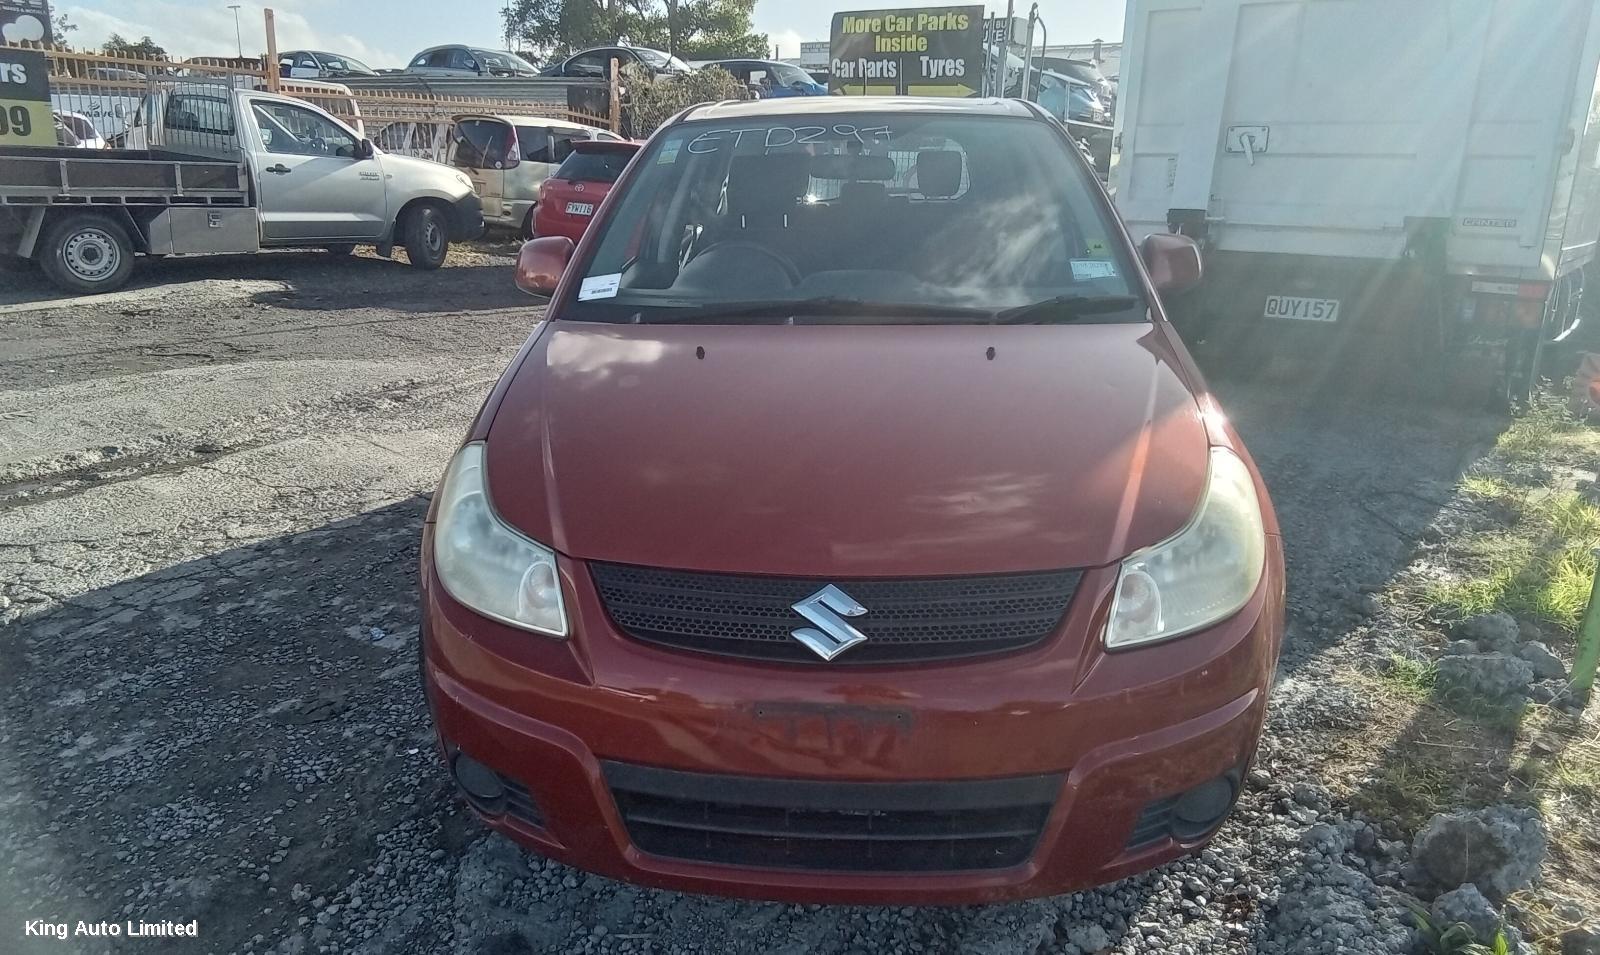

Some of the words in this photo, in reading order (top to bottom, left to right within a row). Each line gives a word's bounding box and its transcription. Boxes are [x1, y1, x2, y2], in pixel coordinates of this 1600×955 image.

[842, 16, 881, 34] More
[885, 14, 914, 33] Car
[917, 12, 969, 31] Parks
[875, 34, 928, 53] Inside
[832, 58, 856, 78] Car
[858, 58, 897, 78] Parts
[920, 56, 965, 79] Tyres
[1266, 298, 1337, 319] QUY157
